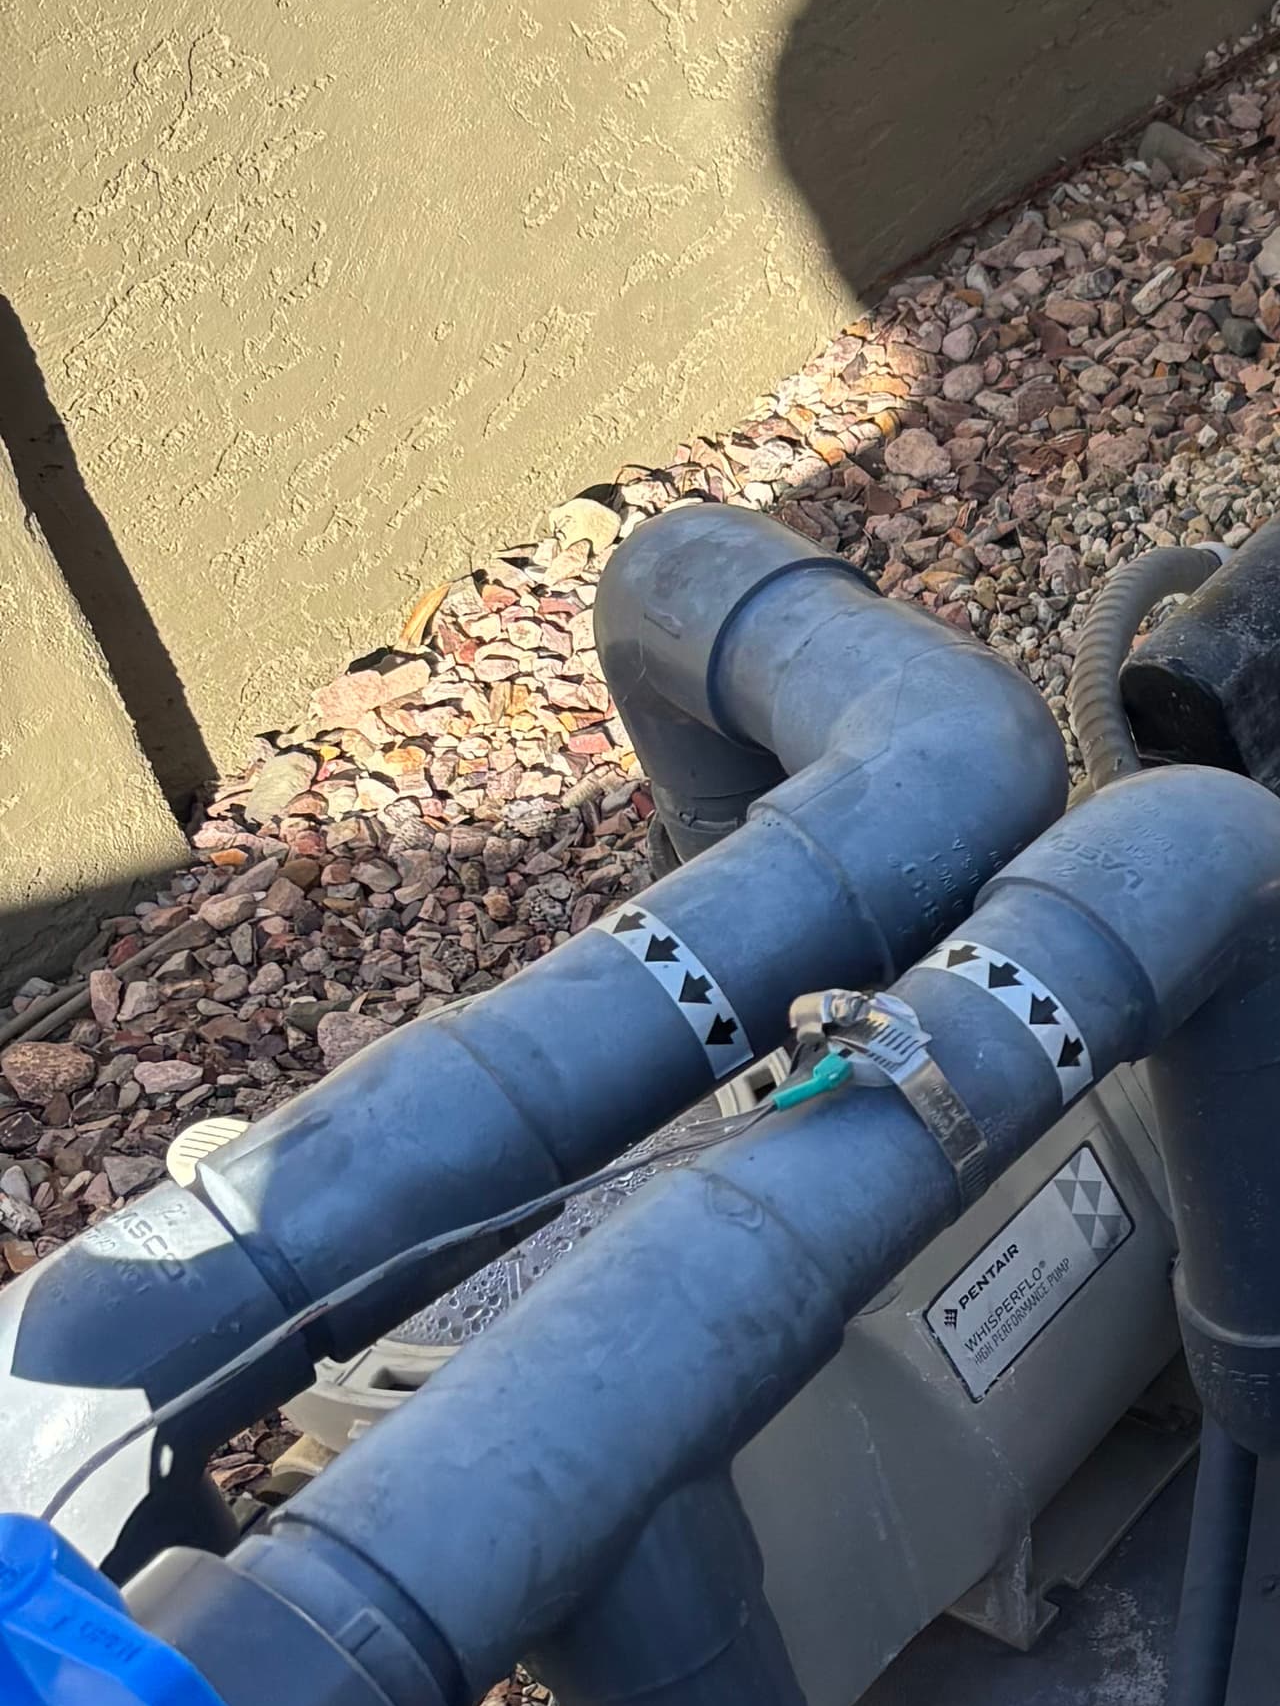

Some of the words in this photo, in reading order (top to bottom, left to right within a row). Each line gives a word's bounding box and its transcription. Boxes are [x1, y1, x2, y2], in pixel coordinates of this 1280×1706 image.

[958, 1243, 1019, 1310] PENTAIR
[974, 1343, 994, 1366] HIGH
[991, 1281, 1050, 1348] PERFORMANCE
[1046, 1257, 1070, 1288] PUMP
